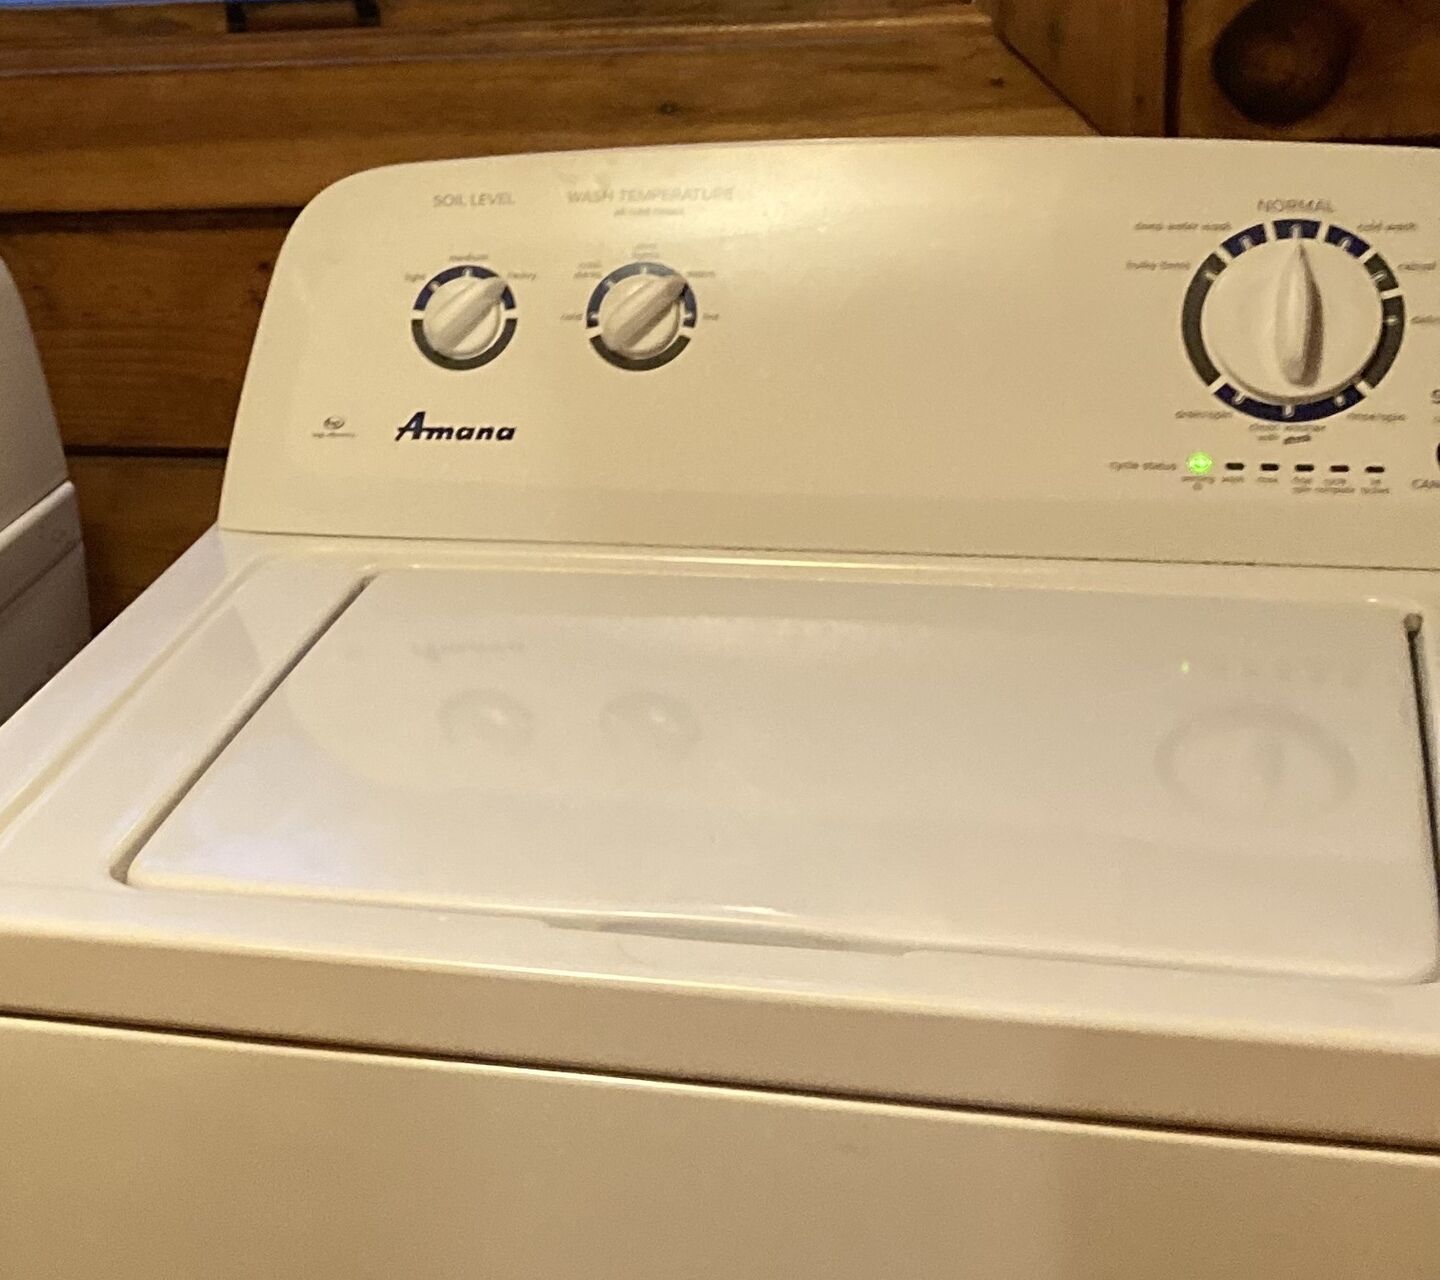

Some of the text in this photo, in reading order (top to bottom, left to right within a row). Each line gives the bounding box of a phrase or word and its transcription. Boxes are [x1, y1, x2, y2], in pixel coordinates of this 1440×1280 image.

[432, 191, 515, 207] SOIL LEVEL
[1256, 198, 1335, 214] NORMAL
[394, 410, 517, 442] Amana
